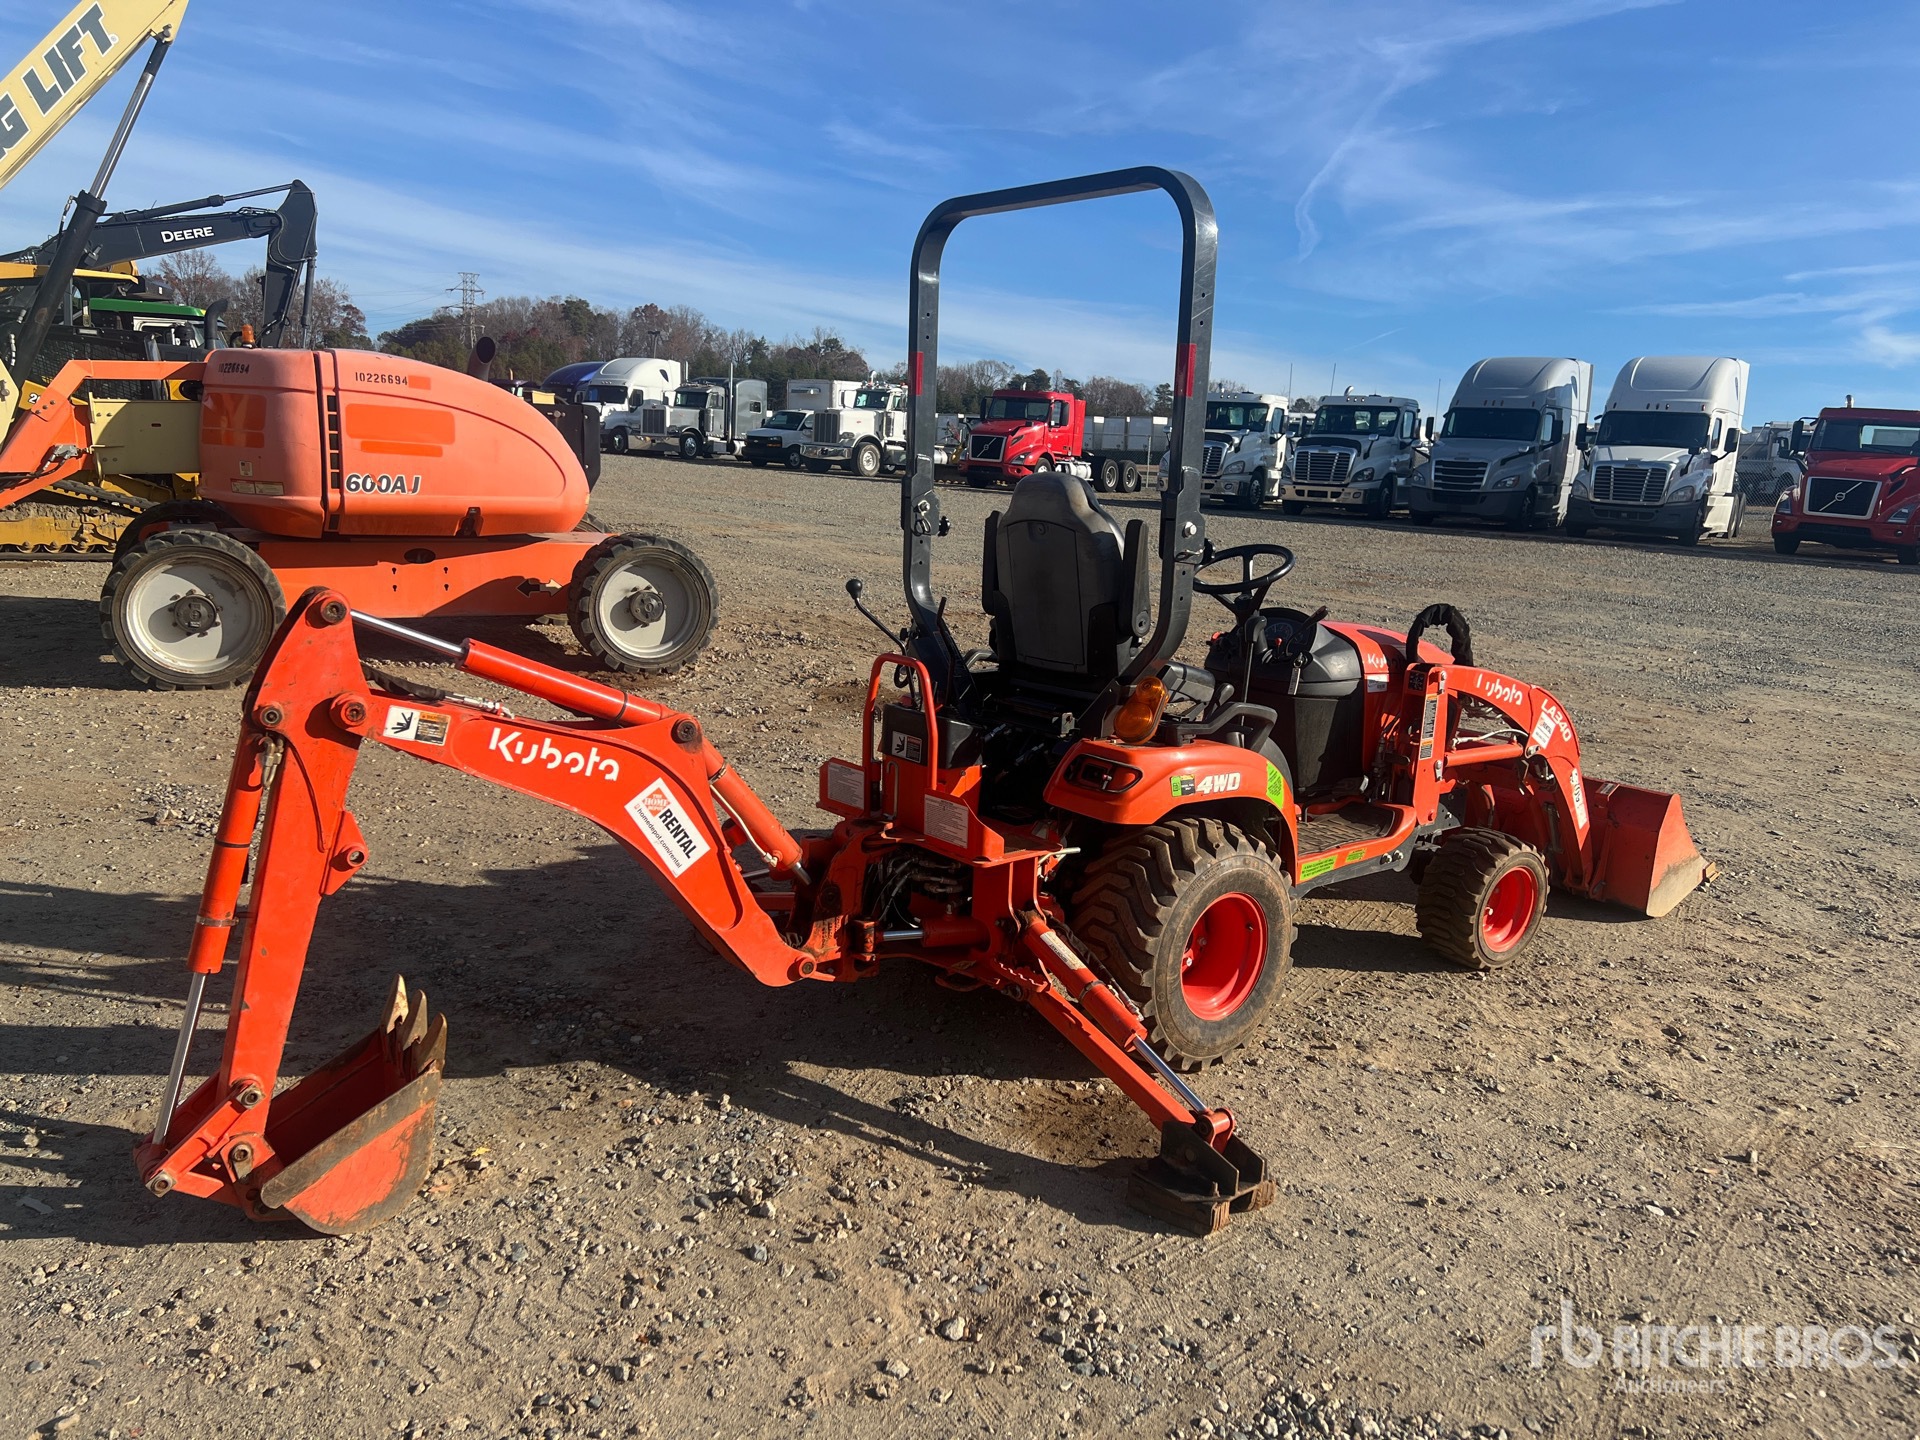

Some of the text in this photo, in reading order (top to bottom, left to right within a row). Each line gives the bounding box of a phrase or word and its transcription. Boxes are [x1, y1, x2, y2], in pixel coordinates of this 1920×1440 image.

[21, 2, 105, 117] LIFT
[160, 226, 215, 243] DEERE
[354, 371, 408, 386] 10226694
[345, 473, 421, 495] 600AJ
[1541, 698, 1572, 742] LA340
[488, 727, 620, 782] Kubota
[1196, 772, 1241, 795] 4WD
[636, 808, 683, 869] homedepot.com/rental
[658, 808, 697, 859] RENTAL
